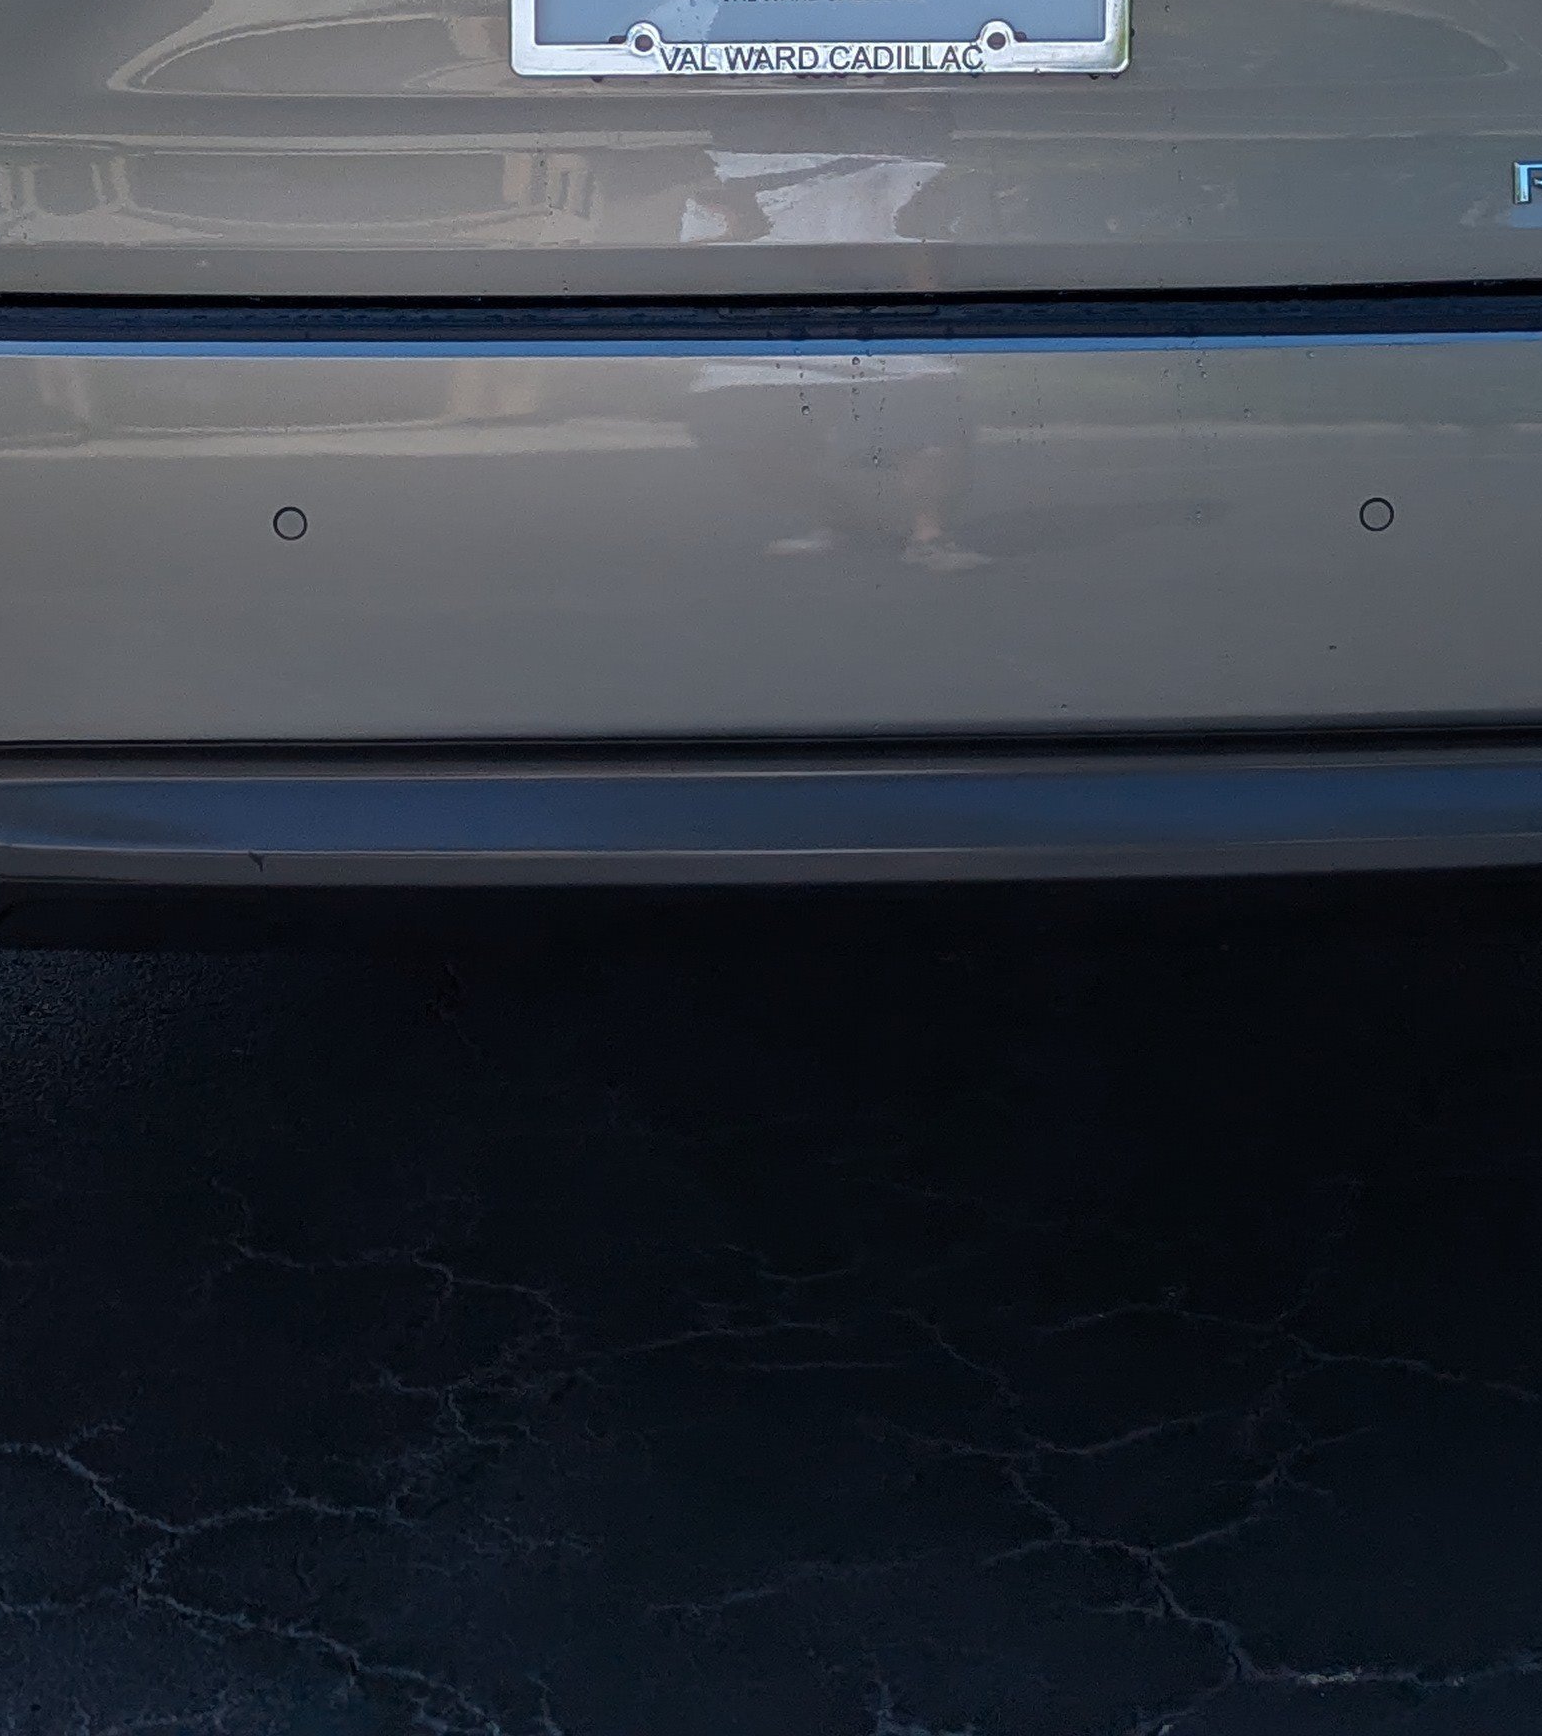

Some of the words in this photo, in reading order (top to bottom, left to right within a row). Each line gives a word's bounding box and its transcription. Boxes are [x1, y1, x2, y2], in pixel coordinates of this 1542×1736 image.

[660, 46, 717, 72] VAL
[724, 46, 820, 71] WARD
[828, 44, 985, 71] CADILLAC
